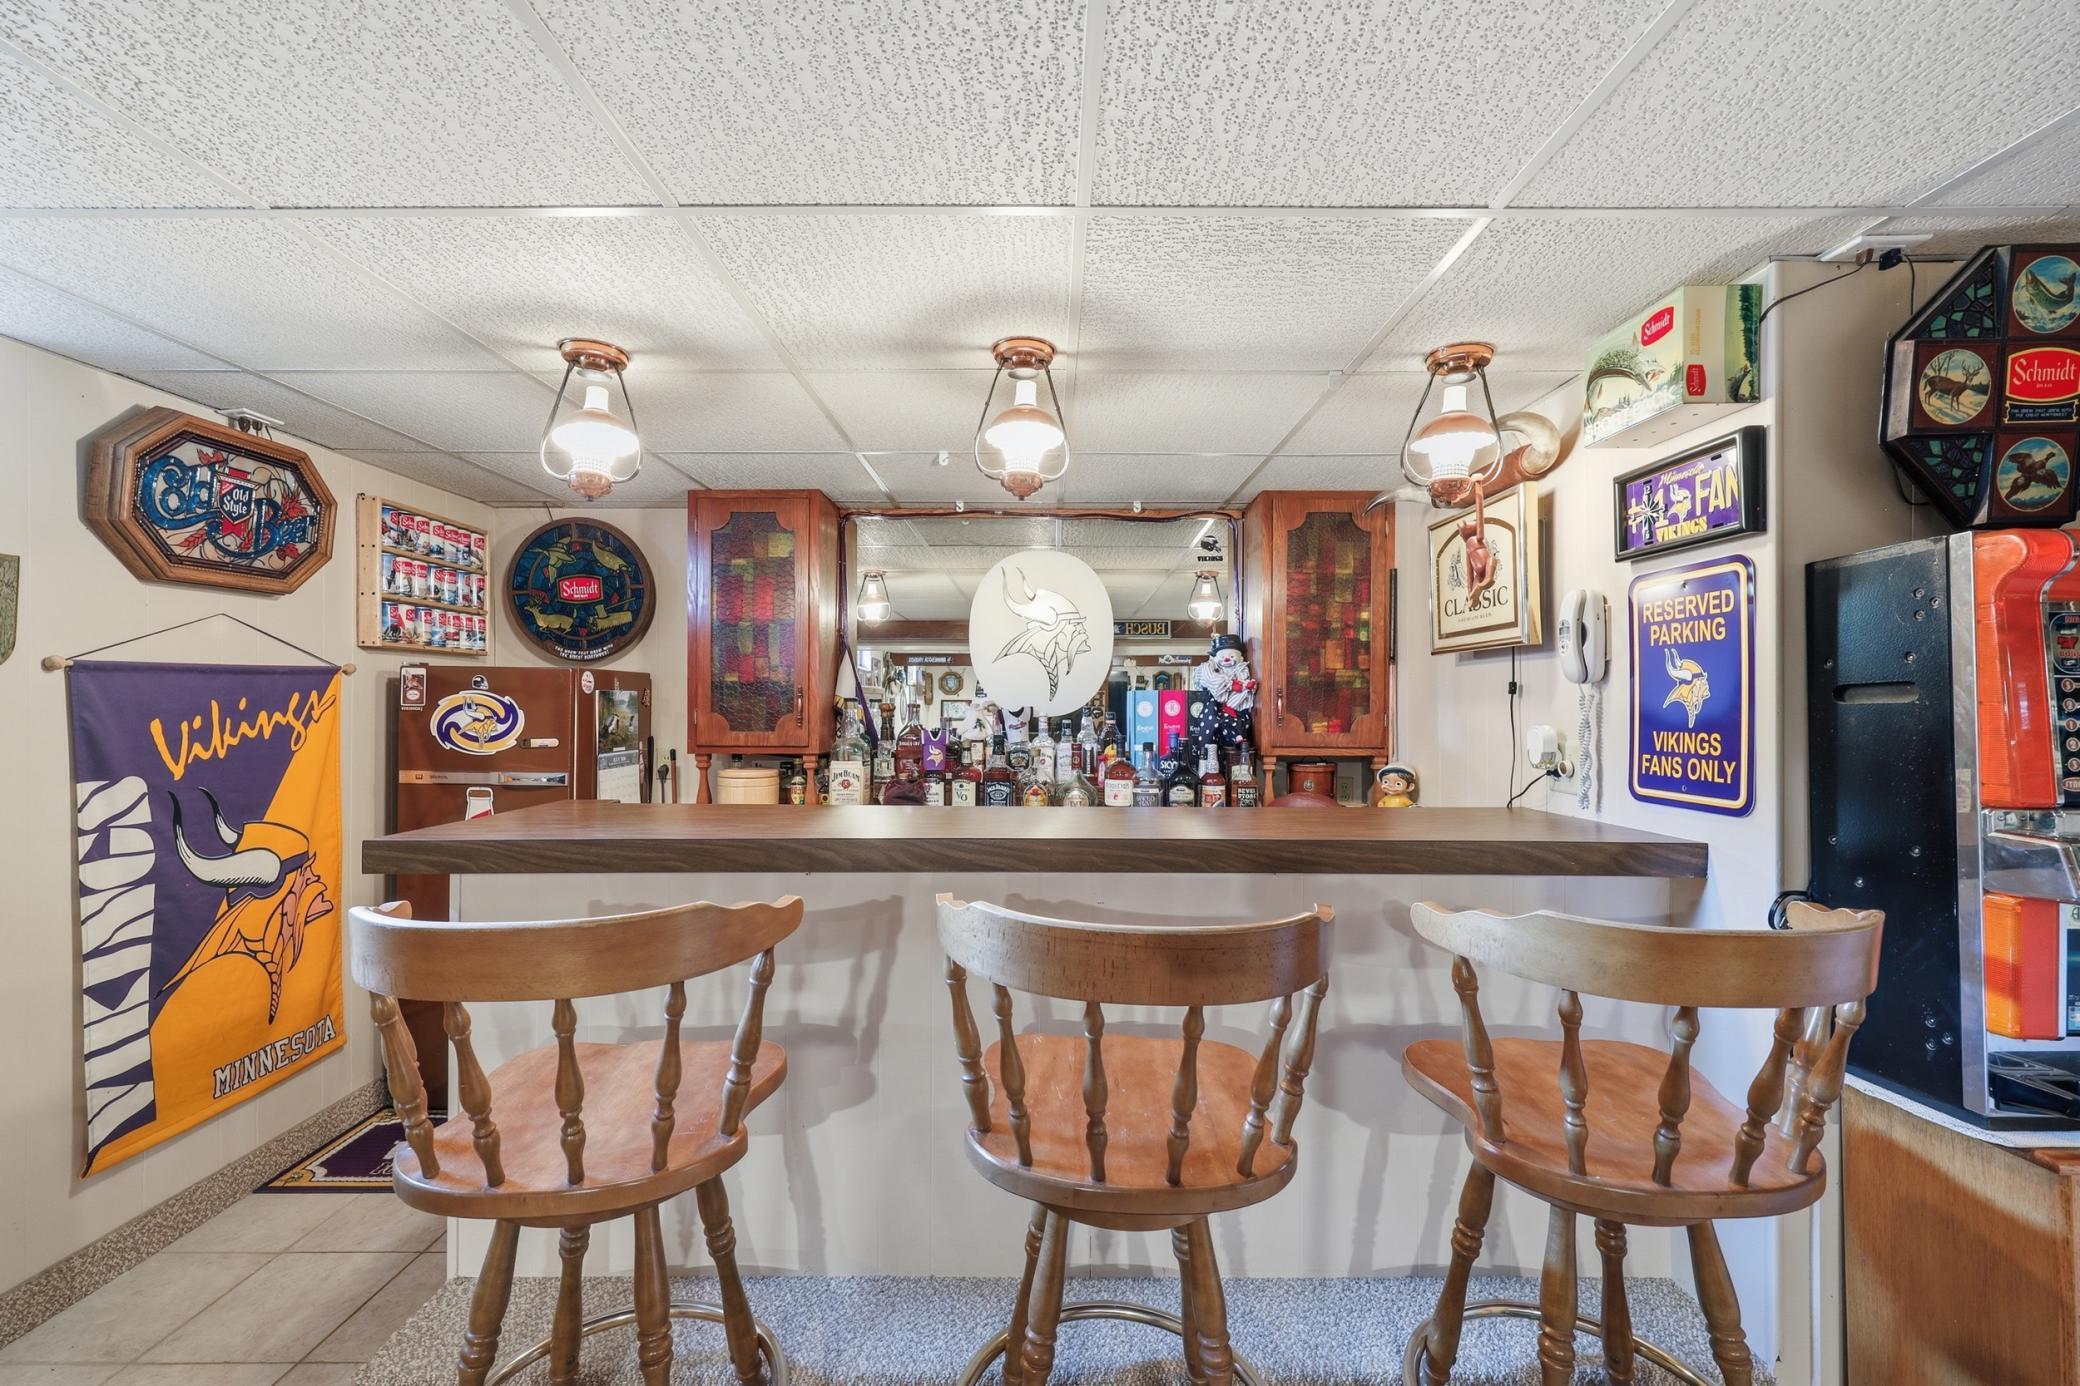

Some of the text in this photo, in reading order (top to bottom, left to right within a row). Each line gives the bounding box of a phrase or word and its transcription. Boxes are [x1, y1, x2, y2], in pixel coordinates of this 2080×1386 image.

[1643, 312, 1670, 340] Schmidt
[2013, 358, 2077, 385] Schmidt
[232, 487, 249, 503] Old
[1695, 463, 1739, 516] FAN
[222, 496, 248, 517] Style
[1656, 516, 1708, 543] VIKINGS
[562, 581, 599, 597] Schmidt
[1643, 589, 1735, 624] RESERVED
[1650, 617, 1726, 647] PARKING
[150, 689, 336, 781] Vikings
[1653, 730, 1722, 756] VIKINGS
[1641, 754, 1736, 785] FANS ONLY
[212, 1014, 336, 1100] MINNESOTA
